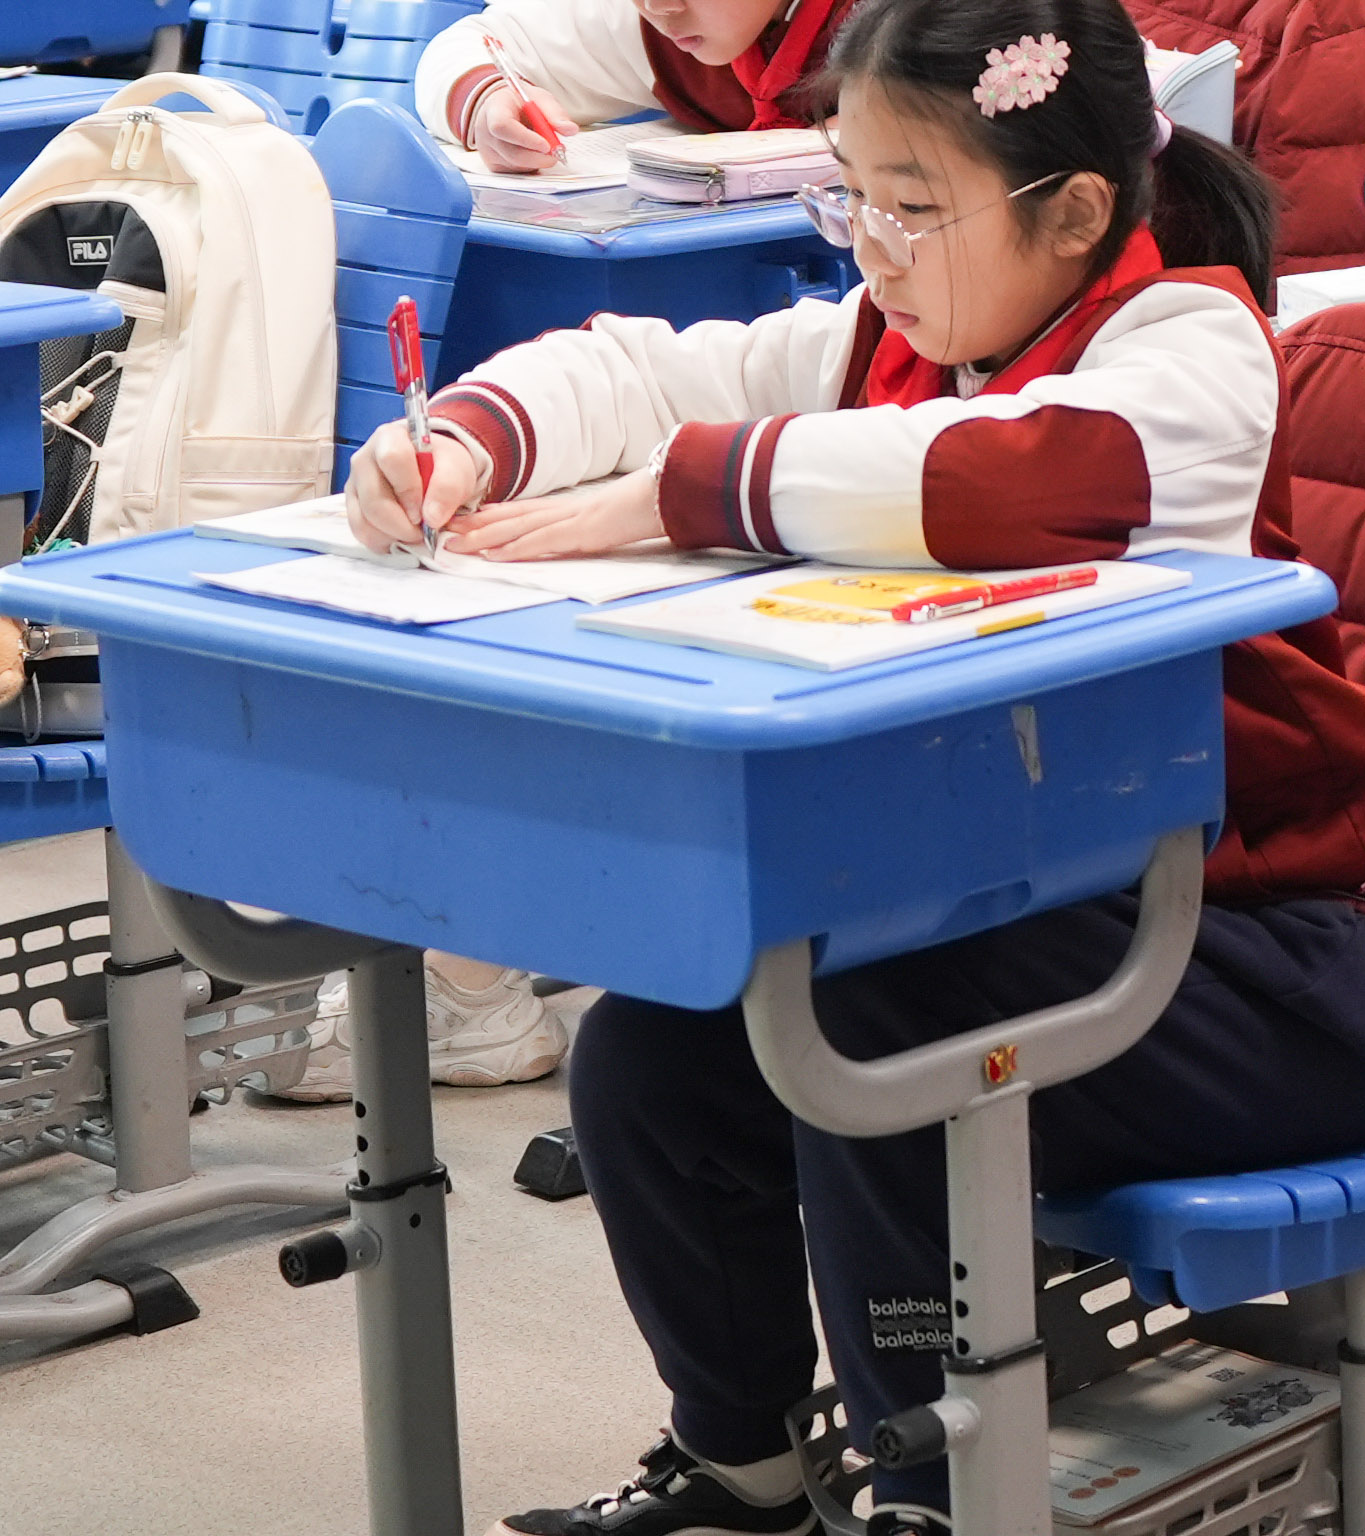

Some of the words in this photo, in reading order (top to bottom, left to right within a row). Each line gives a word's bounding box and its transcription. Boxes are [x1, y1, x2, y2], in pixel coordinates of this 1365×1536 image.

[73, 243, 107, 260] FILA
[868, 1296, 947, 1317] balabala
[873, 1328, 953, 1348] balabala
